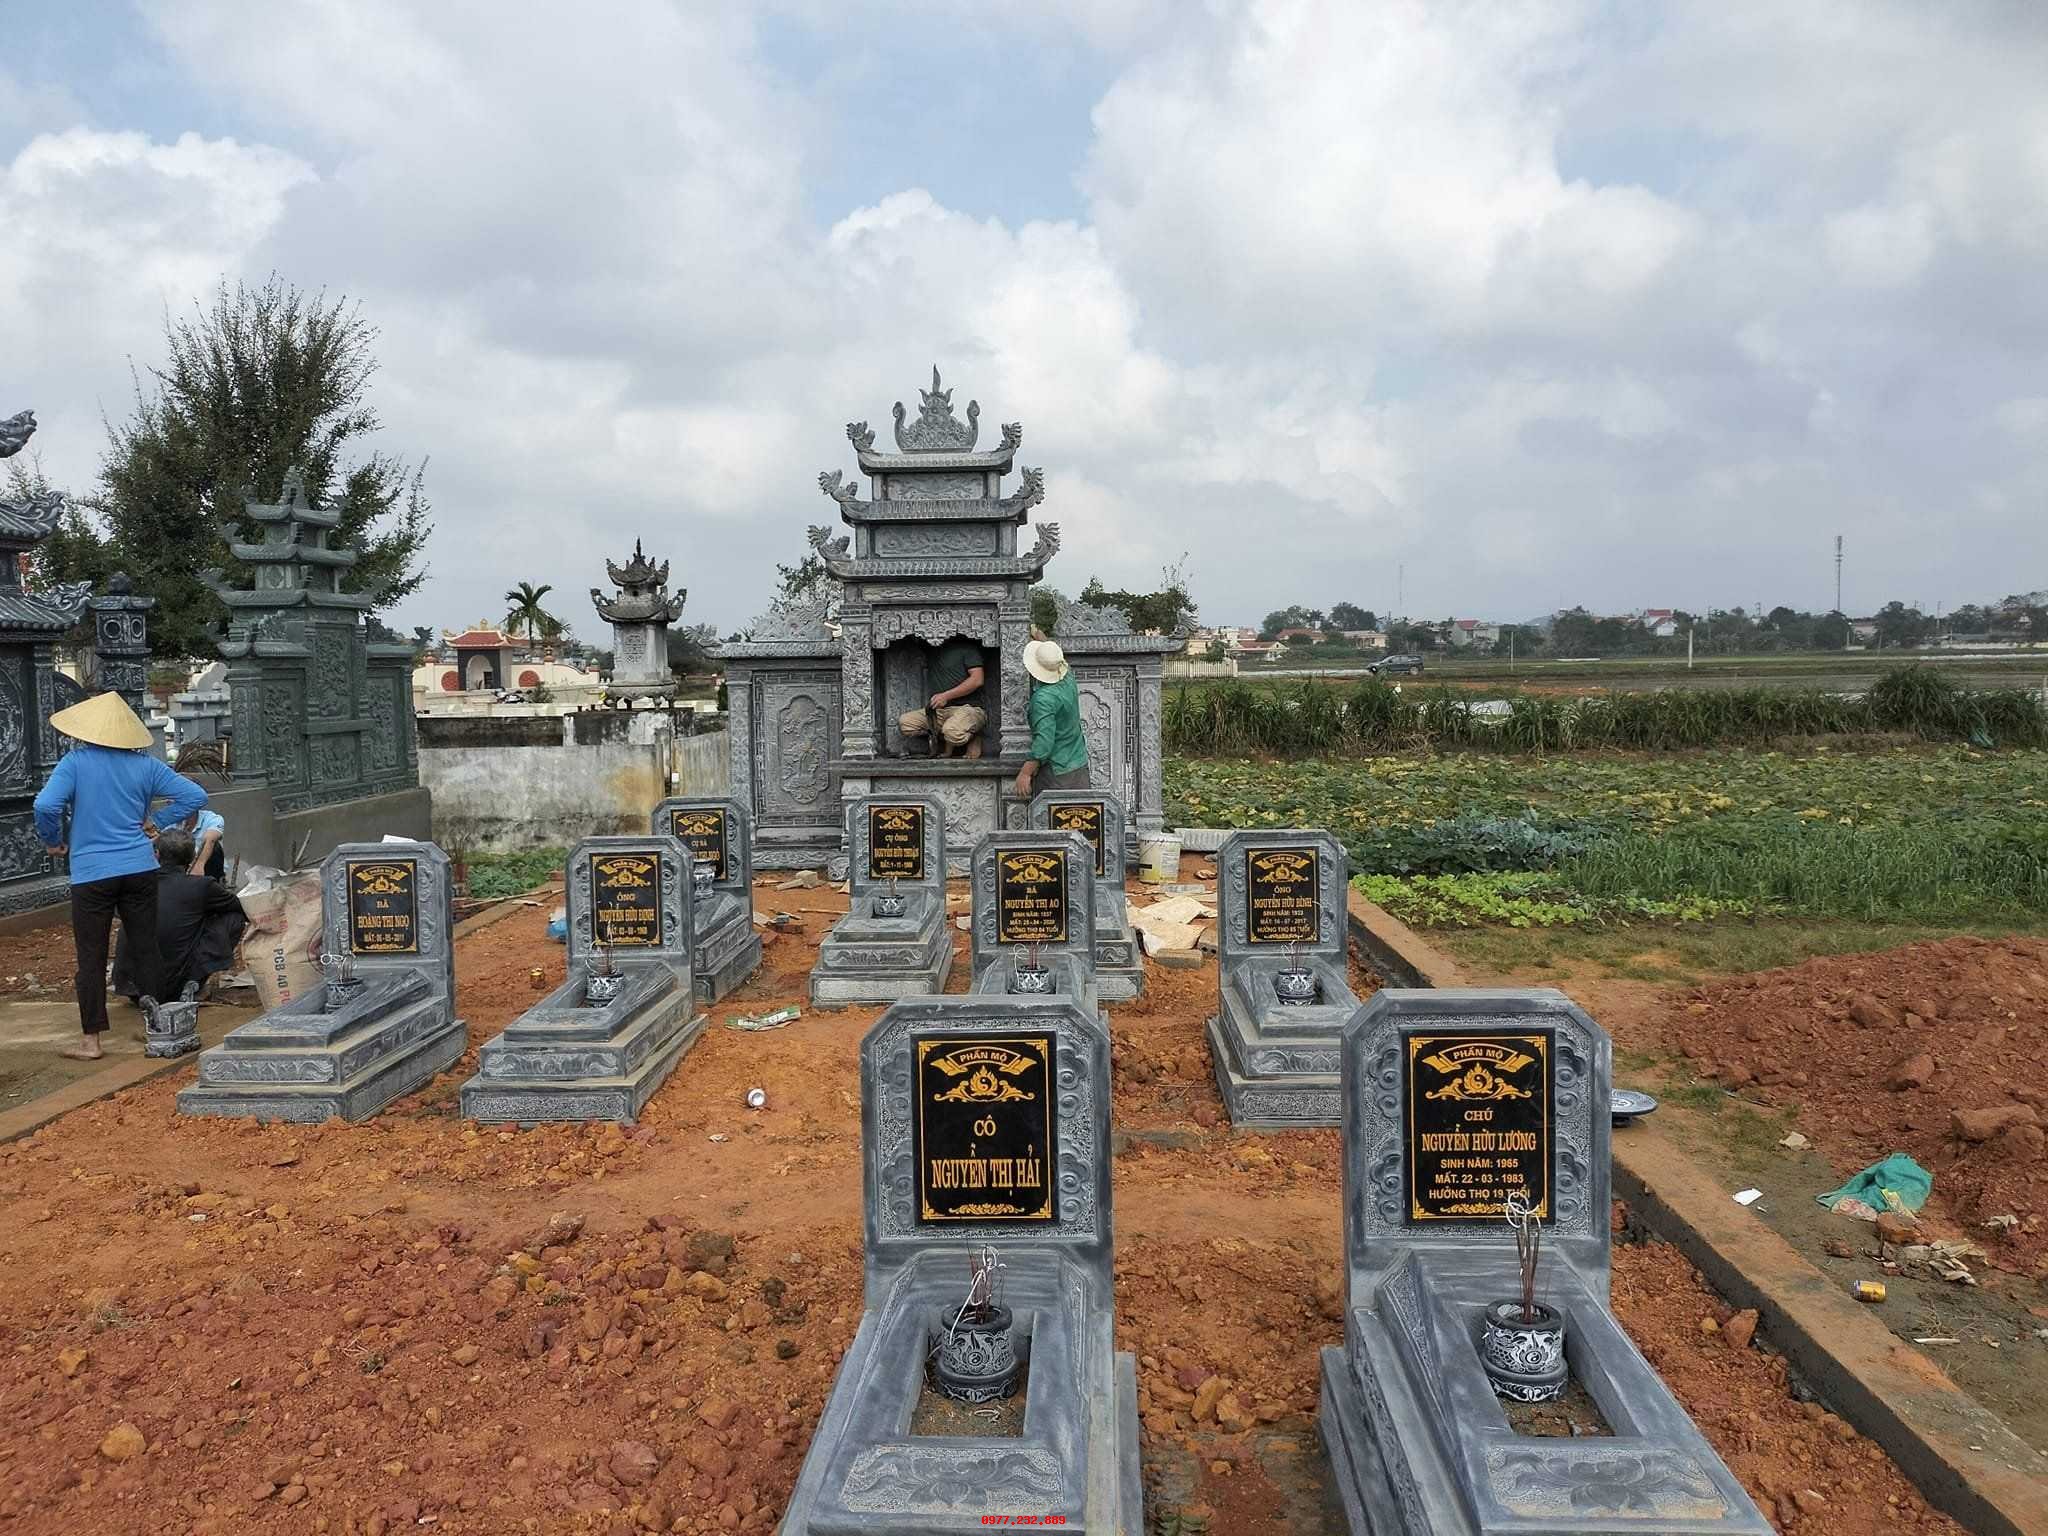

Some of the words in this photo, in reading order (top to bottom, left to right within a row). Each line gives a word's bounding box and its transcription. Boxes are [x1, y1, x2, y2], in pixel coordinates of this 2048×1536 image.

[1464, 1107, 1493, 1121] CHÚ
[973, 1114, 996, 1136] CÔ
[1498, 1130, 1536, 1150] LƯƠNG
[1440, 1159, 1464, 1169] SINH
[1467, 1157, 1493, 1169] NĂM:
[990, 1158, 1013, 1197] THỊ
[1016, 1144, 1041, 1188] HẢI
[1461, 1174, 1473, 1184] 22
[1481, 1174, 1492, 1184] 03
[1469, 1189, 1490, 1201] THỌ
[1493, 1189, 1504, 1198] 19
